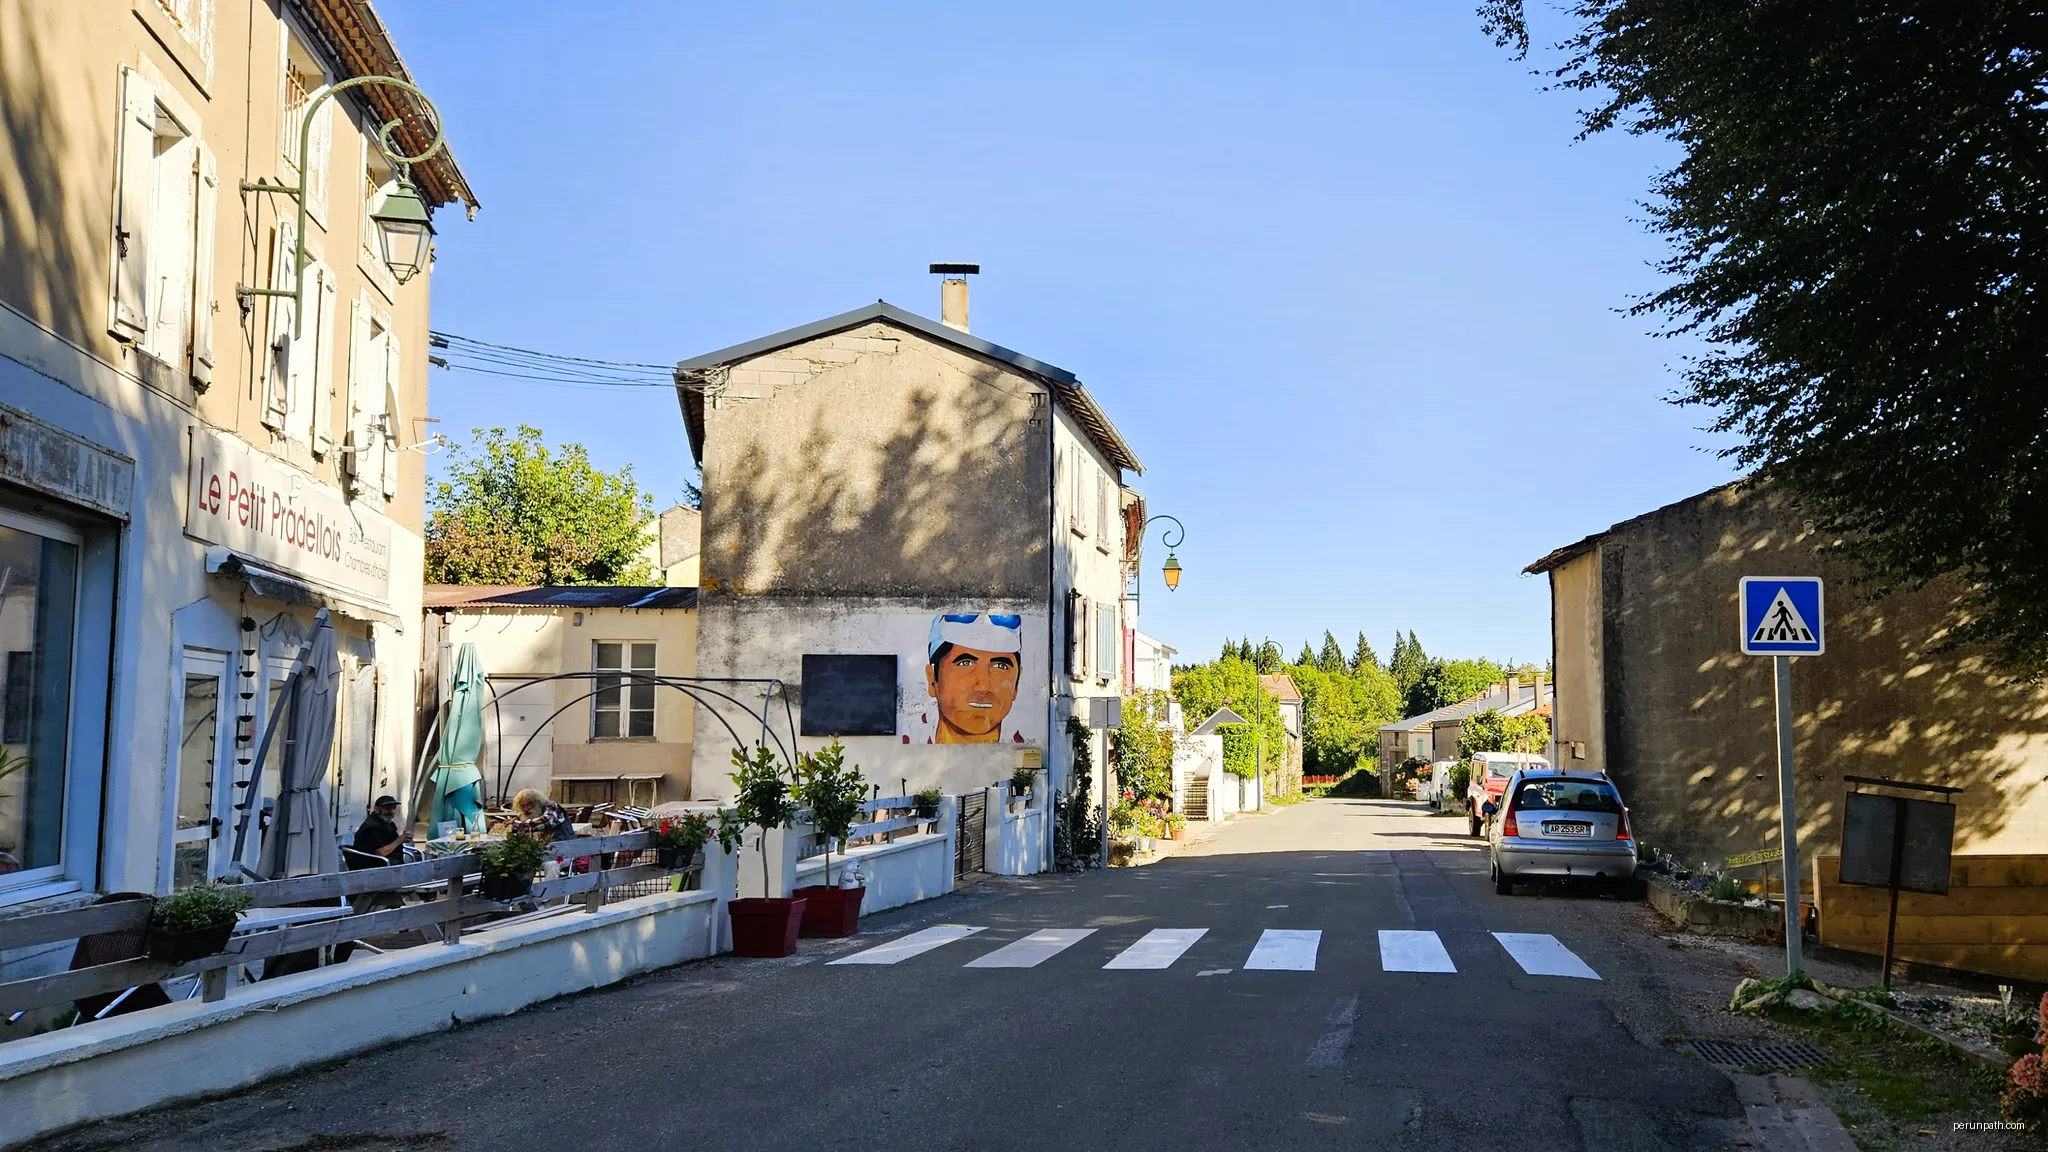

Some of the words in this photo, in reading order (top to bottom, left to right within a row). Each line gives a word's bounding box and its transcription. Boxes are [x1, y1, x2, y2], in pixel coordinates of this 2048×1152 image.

[198, 456, 221, 516] Le
[227, 470, 266, 533] Petit
[271, 491, 341, 562] Pradellois
[1550, 825, 1560, 833] AR
[1561, 825, 1575, 833] 253
[1576, 826, 1585, 834] SR
